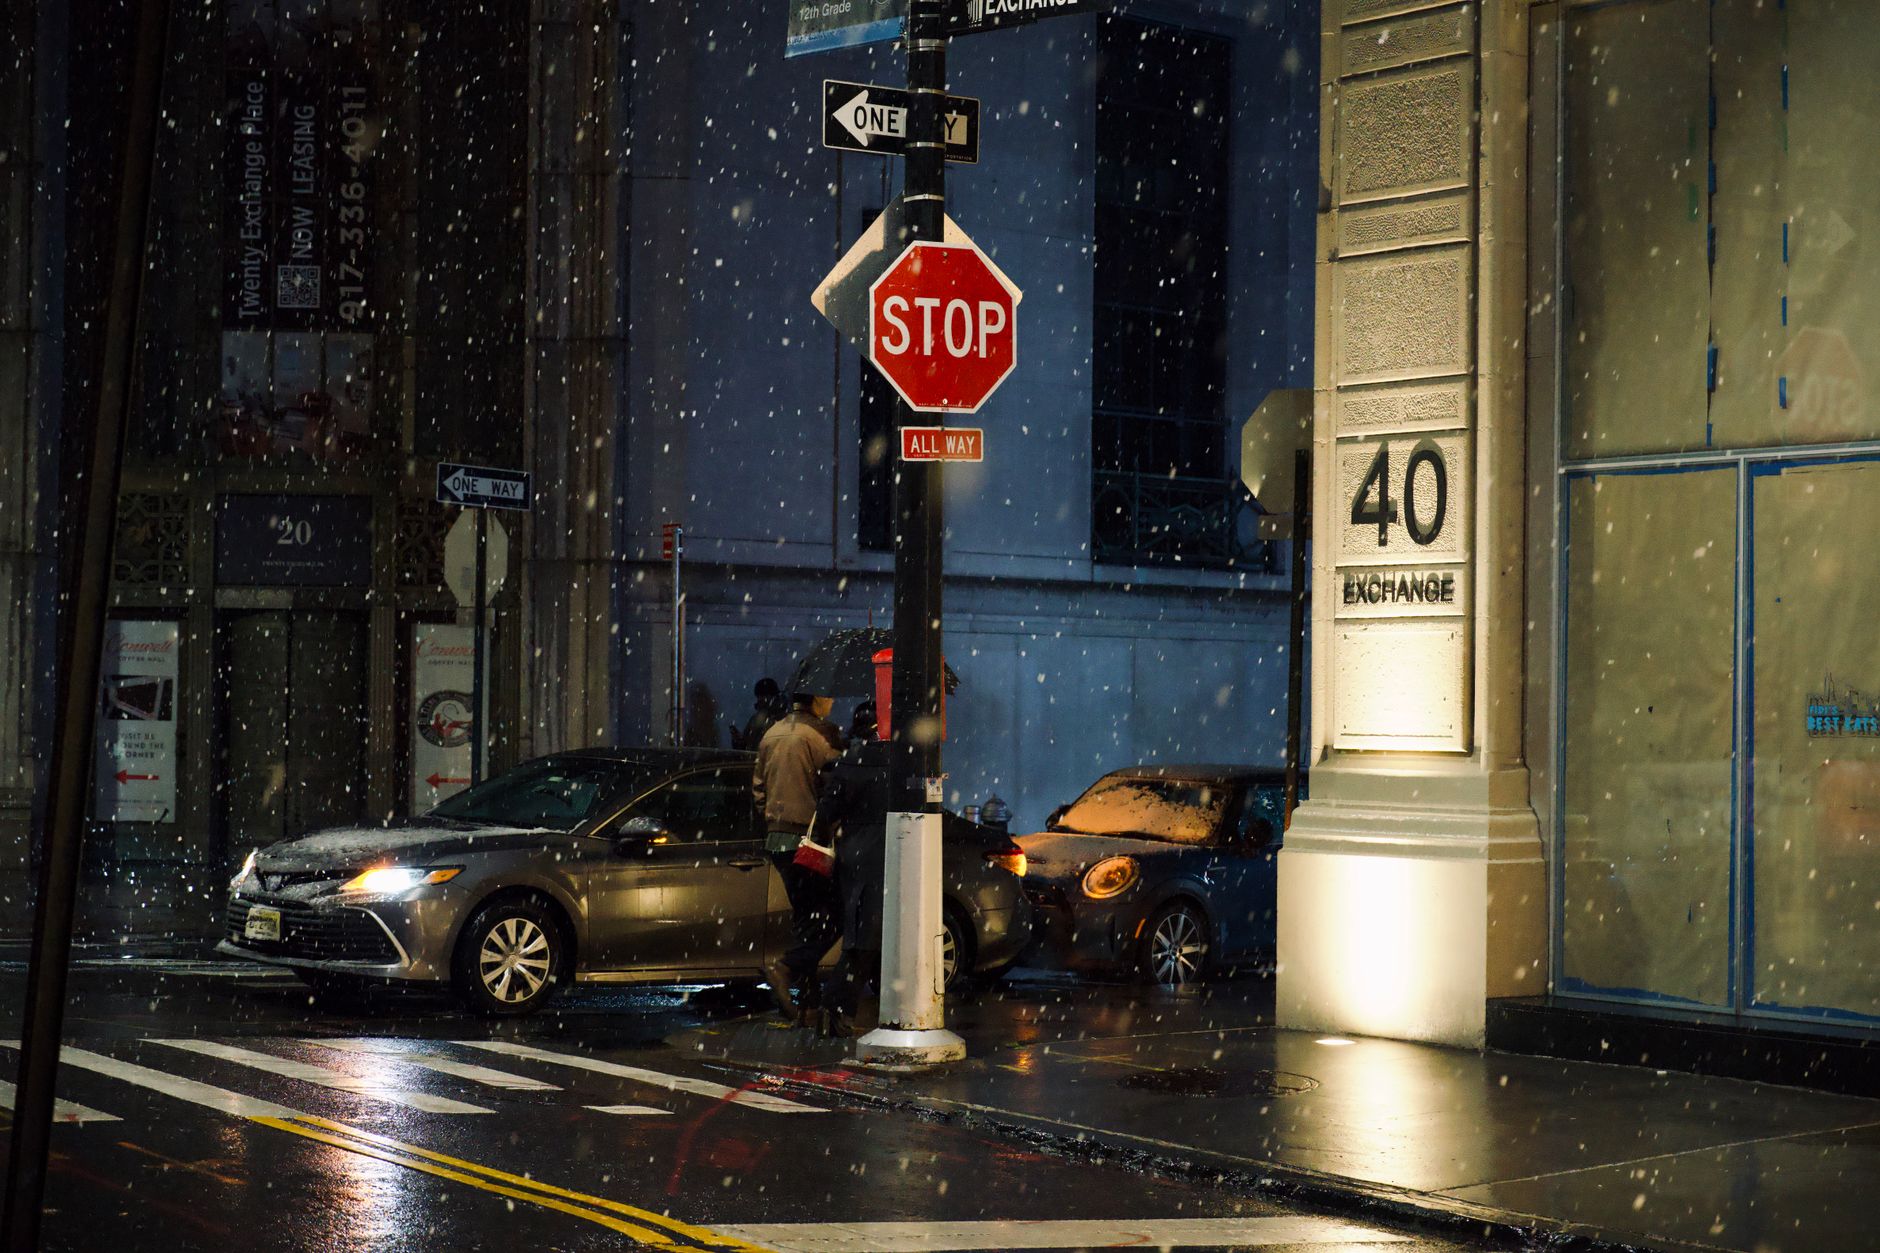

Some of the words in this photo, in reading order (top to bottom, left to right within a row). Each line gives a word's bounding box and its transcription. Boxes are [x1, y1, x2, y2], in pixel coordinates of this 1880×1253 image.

[799, 5, 819, 21] 12th
[821, 0, 851, 17] Grade
[985, 0, 1078, 15] EXCHA
[240, 81, 264, 135] Place
[854, 106, 899, 134] ONE
[292, 105, 316, 195] LEASING
[240, 141, 266, 240] Exchange
[339, 85, 367, 324] 917-336-4011
[292, 206, 314, 259] NOW
[238, 246, 264, 319] Twenty
[881, 295, 1006, 359] STOP
[910, 434, 940, 453] ALL
[945, 435, 975, 454] WAY
[452, 477, 478, 493] ONE
[491, 480, 518, 497] WAY
[1351, 449, 1447, 546] 40
[276, 518, 312, 546] 20
[1343, 578, 1454, 604] EXCHANGE
[1807, 717, 1840, 731] BEST
[122, 751, 155, 759] ORNER
